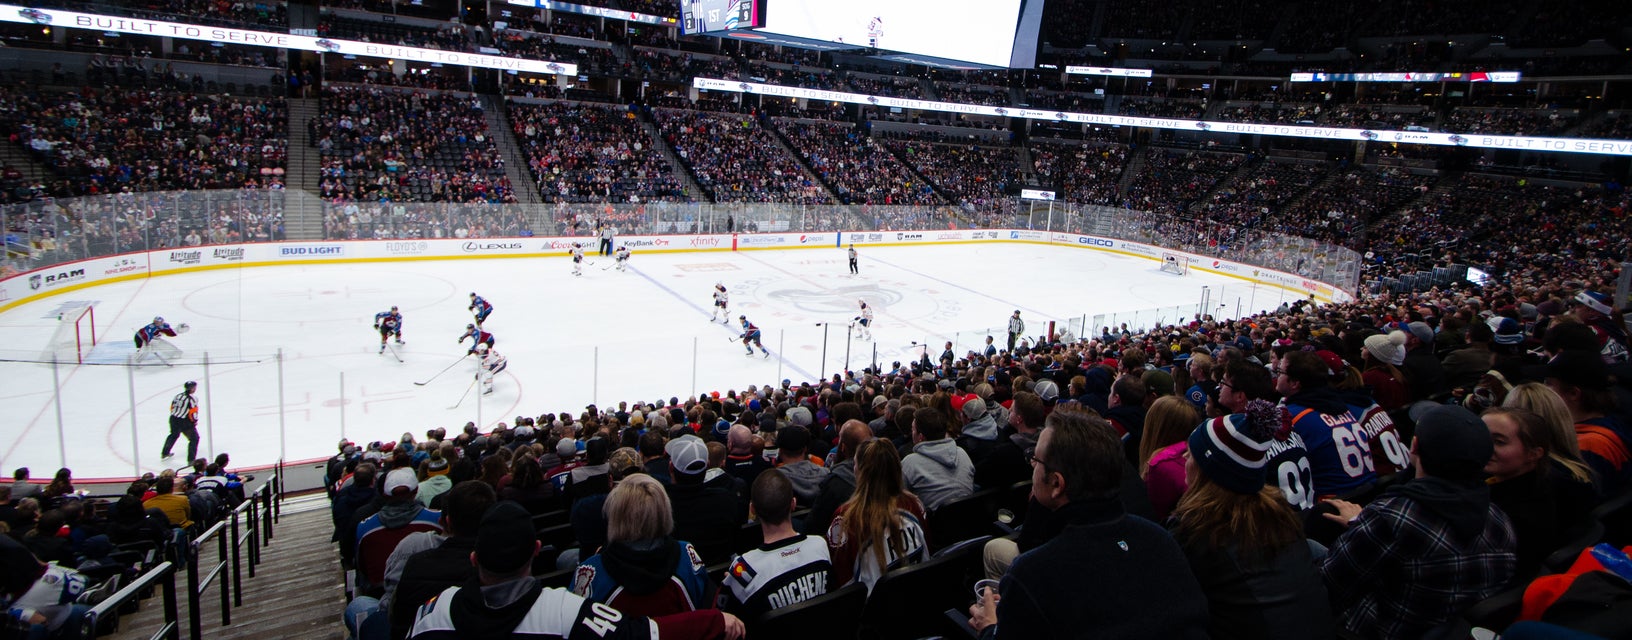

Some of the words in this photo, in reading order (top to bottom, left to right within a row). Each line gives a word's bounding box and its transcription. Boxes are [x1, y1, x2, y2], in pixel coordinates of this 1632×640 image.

[708, 9, 720, 23] 1ST
[743, 11, 749, 21] 9
[76, 15, 158, 33] BUILT
[168, 25, 200, 38] TO
[212, 29, 289, 45] SERVE
[687, 20, 692, 29] 2
[366, 45, 426, 58] BUILT
[435, 53, 459, 63] TO
[468, 56, 525, 69] SERVE
[762, 85, 796, 97] BUILT
[803, 90, 816, 98] TO
[820, 92, 855, 101] SERVE
[890, 98, 922, 107] BUILT
[928, 102, 942, 110] TO
[946, 104, 981, 112] SERVE
[1077, 115, 1113, 123] BUILT
[1140, 119, 1182, 128] SERVE
[1226, 124, 1265, 132] BUILT
[1295, 128, 1342, 137] SERVE
[1482, 137, 1535, 147] BUILT
[1543, 140, 1566, 149] TO
[386, 242, 416, 252] FLOYD'S
[690, 235, 720, 247] xfinity
[1079, 236, 1113, 247] GEICO
[281, 247, 306, 255] BUD
[308, 246, 341, 254] LIGHT
[1221, 264, 1238, 272] pepsi
[45, 269, 85, 283] RAM
[1332, 422, 1375, 478] 69
[1278, 456, 1315, 510] 92
[768, 570, 828, 609] DUCHENE
[582, 602, 622, 638] 40
